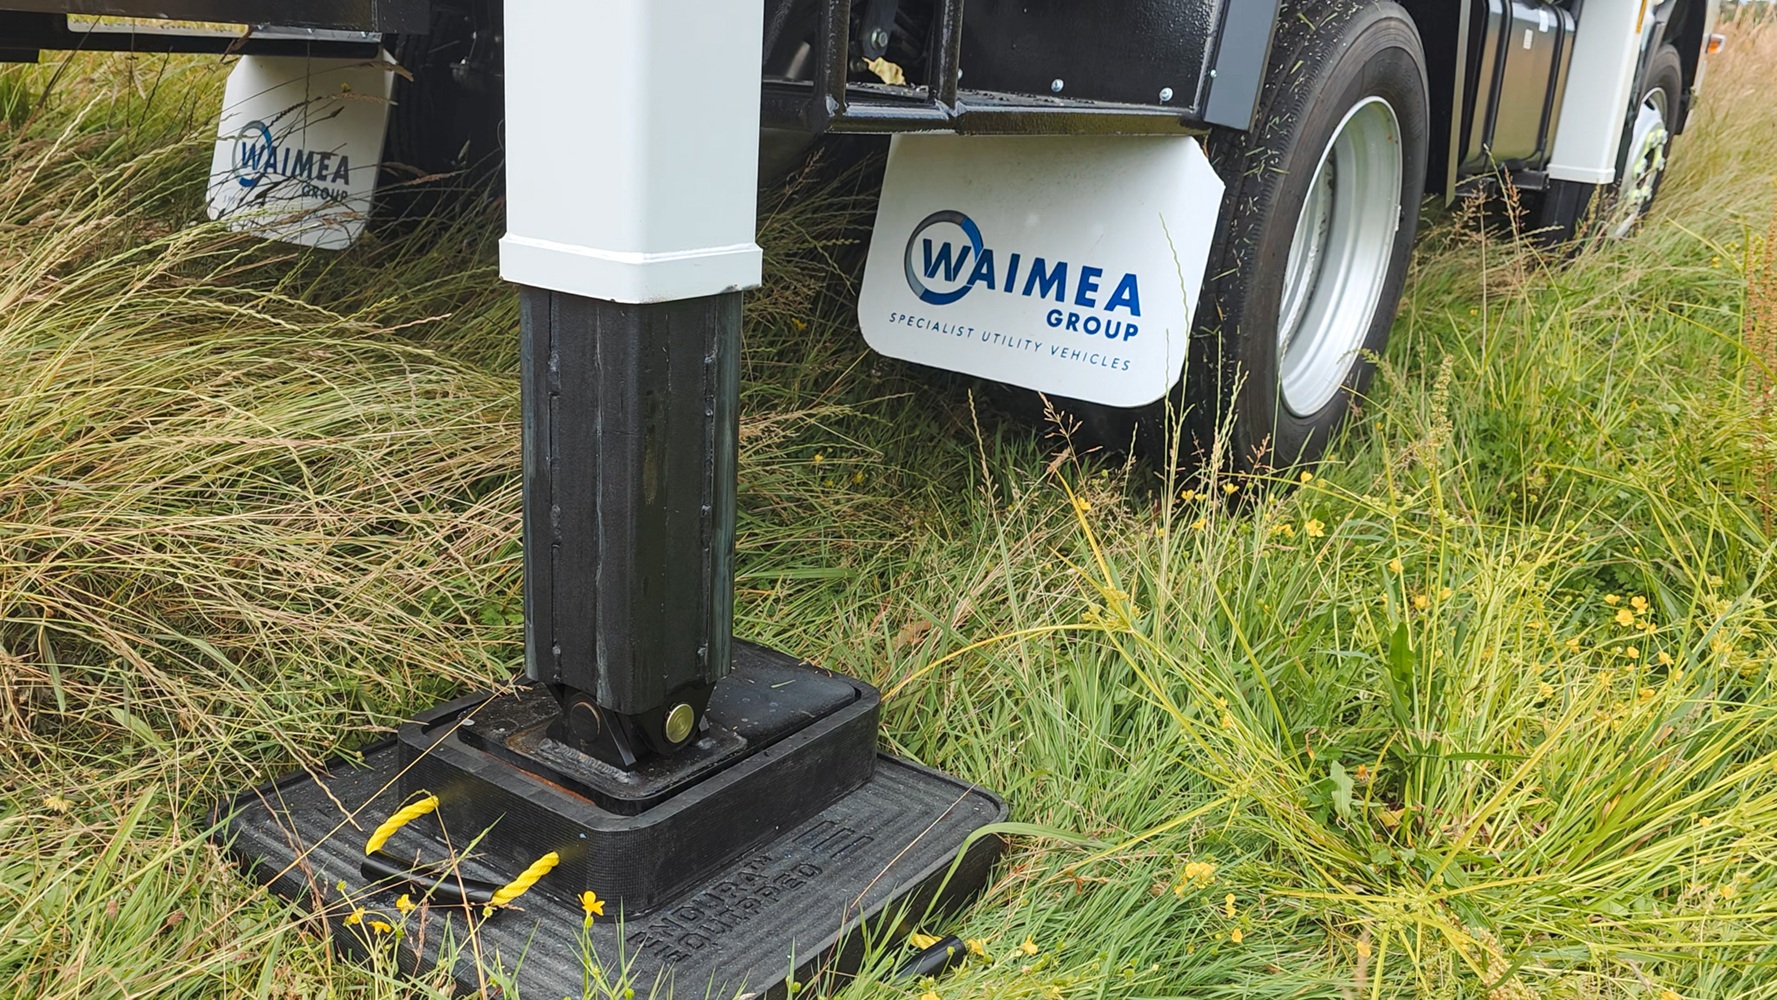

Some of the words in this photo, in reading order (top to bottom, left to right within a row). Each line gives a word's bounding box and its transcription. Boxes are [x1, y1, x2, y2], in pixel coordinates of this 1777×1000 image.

[241, 141, 350, 186] WAIMEA
[301, 184, 348, 201] GROUP
[922, 237, 1142, 318] WAIMEA
[888, 312, 975, 338] SPECIALIST
[981, 331, 1043, 353] UTILITY
[1050, 345, 1131, 372] VEHICLES
[1046, 308, 1139, 342] GROUP
[654, 861, 823, 964] EQUIPPED
